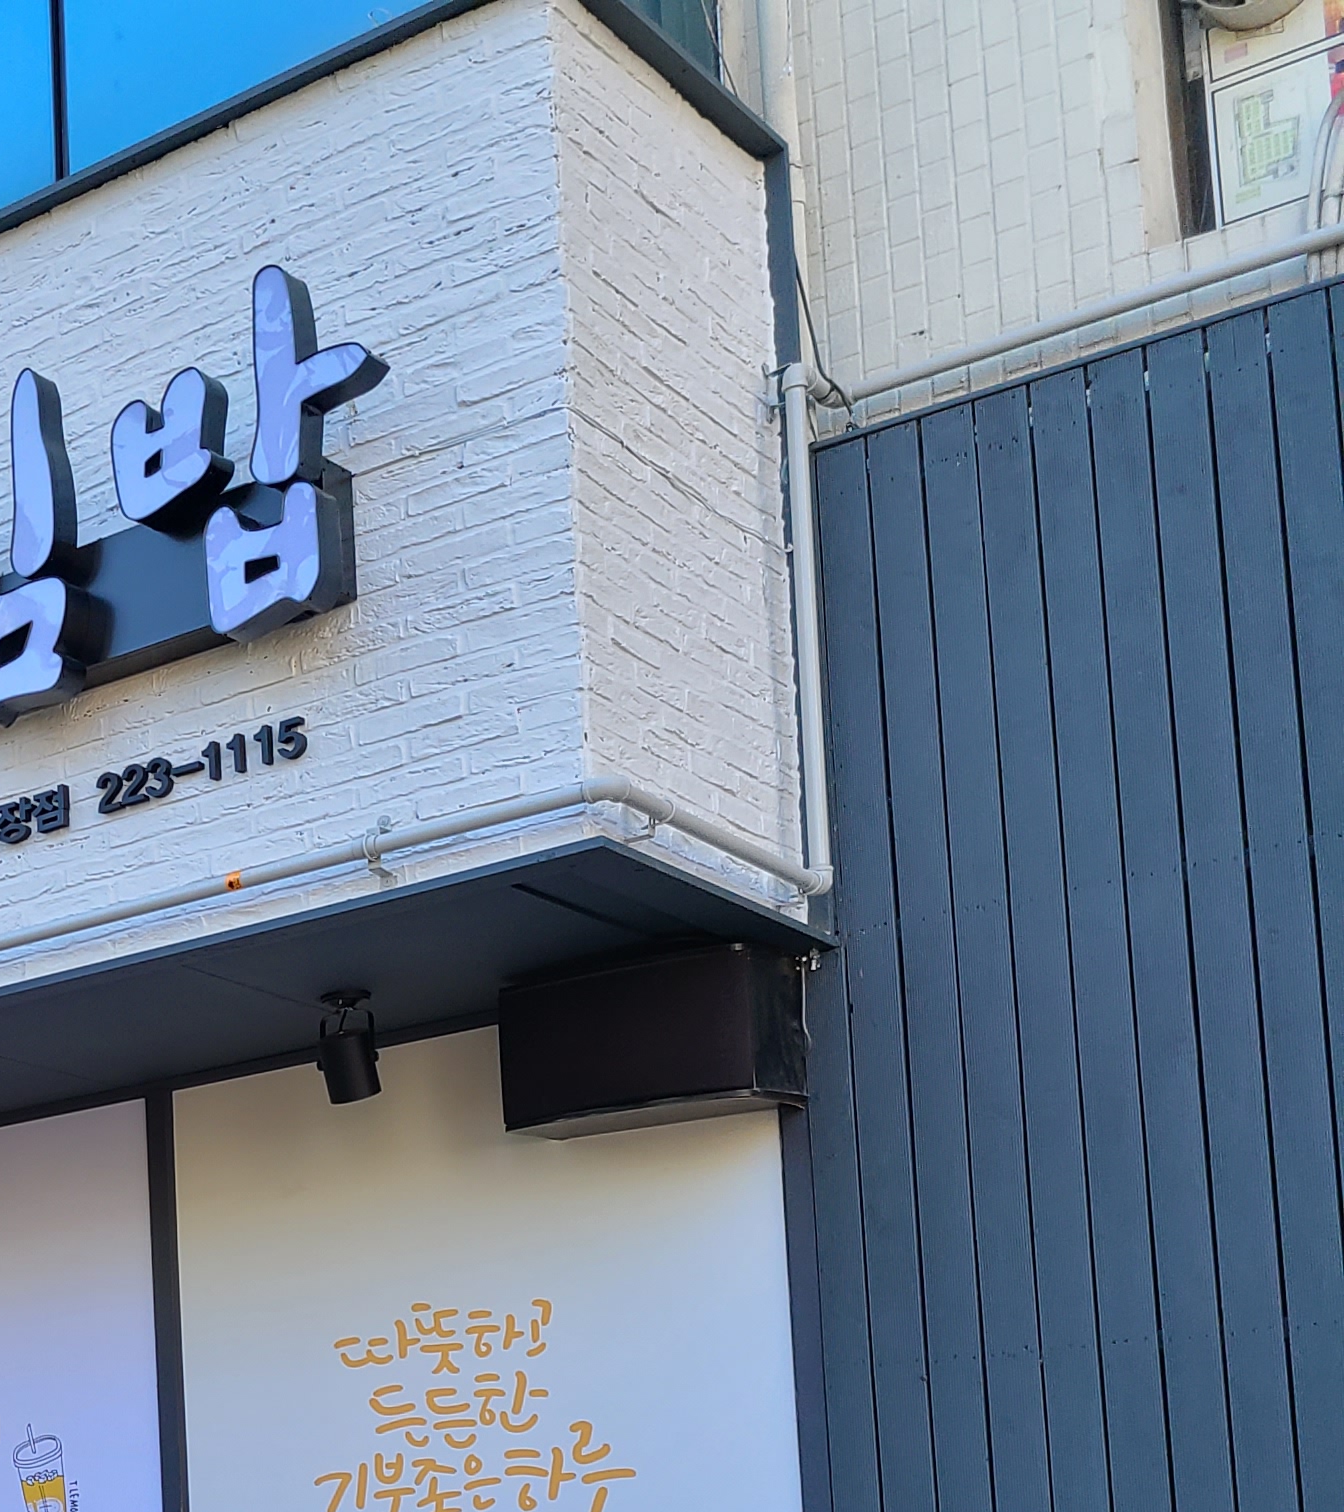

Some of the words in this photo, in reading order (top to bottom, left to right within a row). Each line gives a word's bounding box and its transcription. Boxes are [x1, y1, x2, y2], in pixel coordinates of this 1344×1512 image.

[96, 716, 308, 814] 223-1115
[333, 1298, 553, 1375] 따뜻하고
[368, 1370, 550, 1449] 든든한
